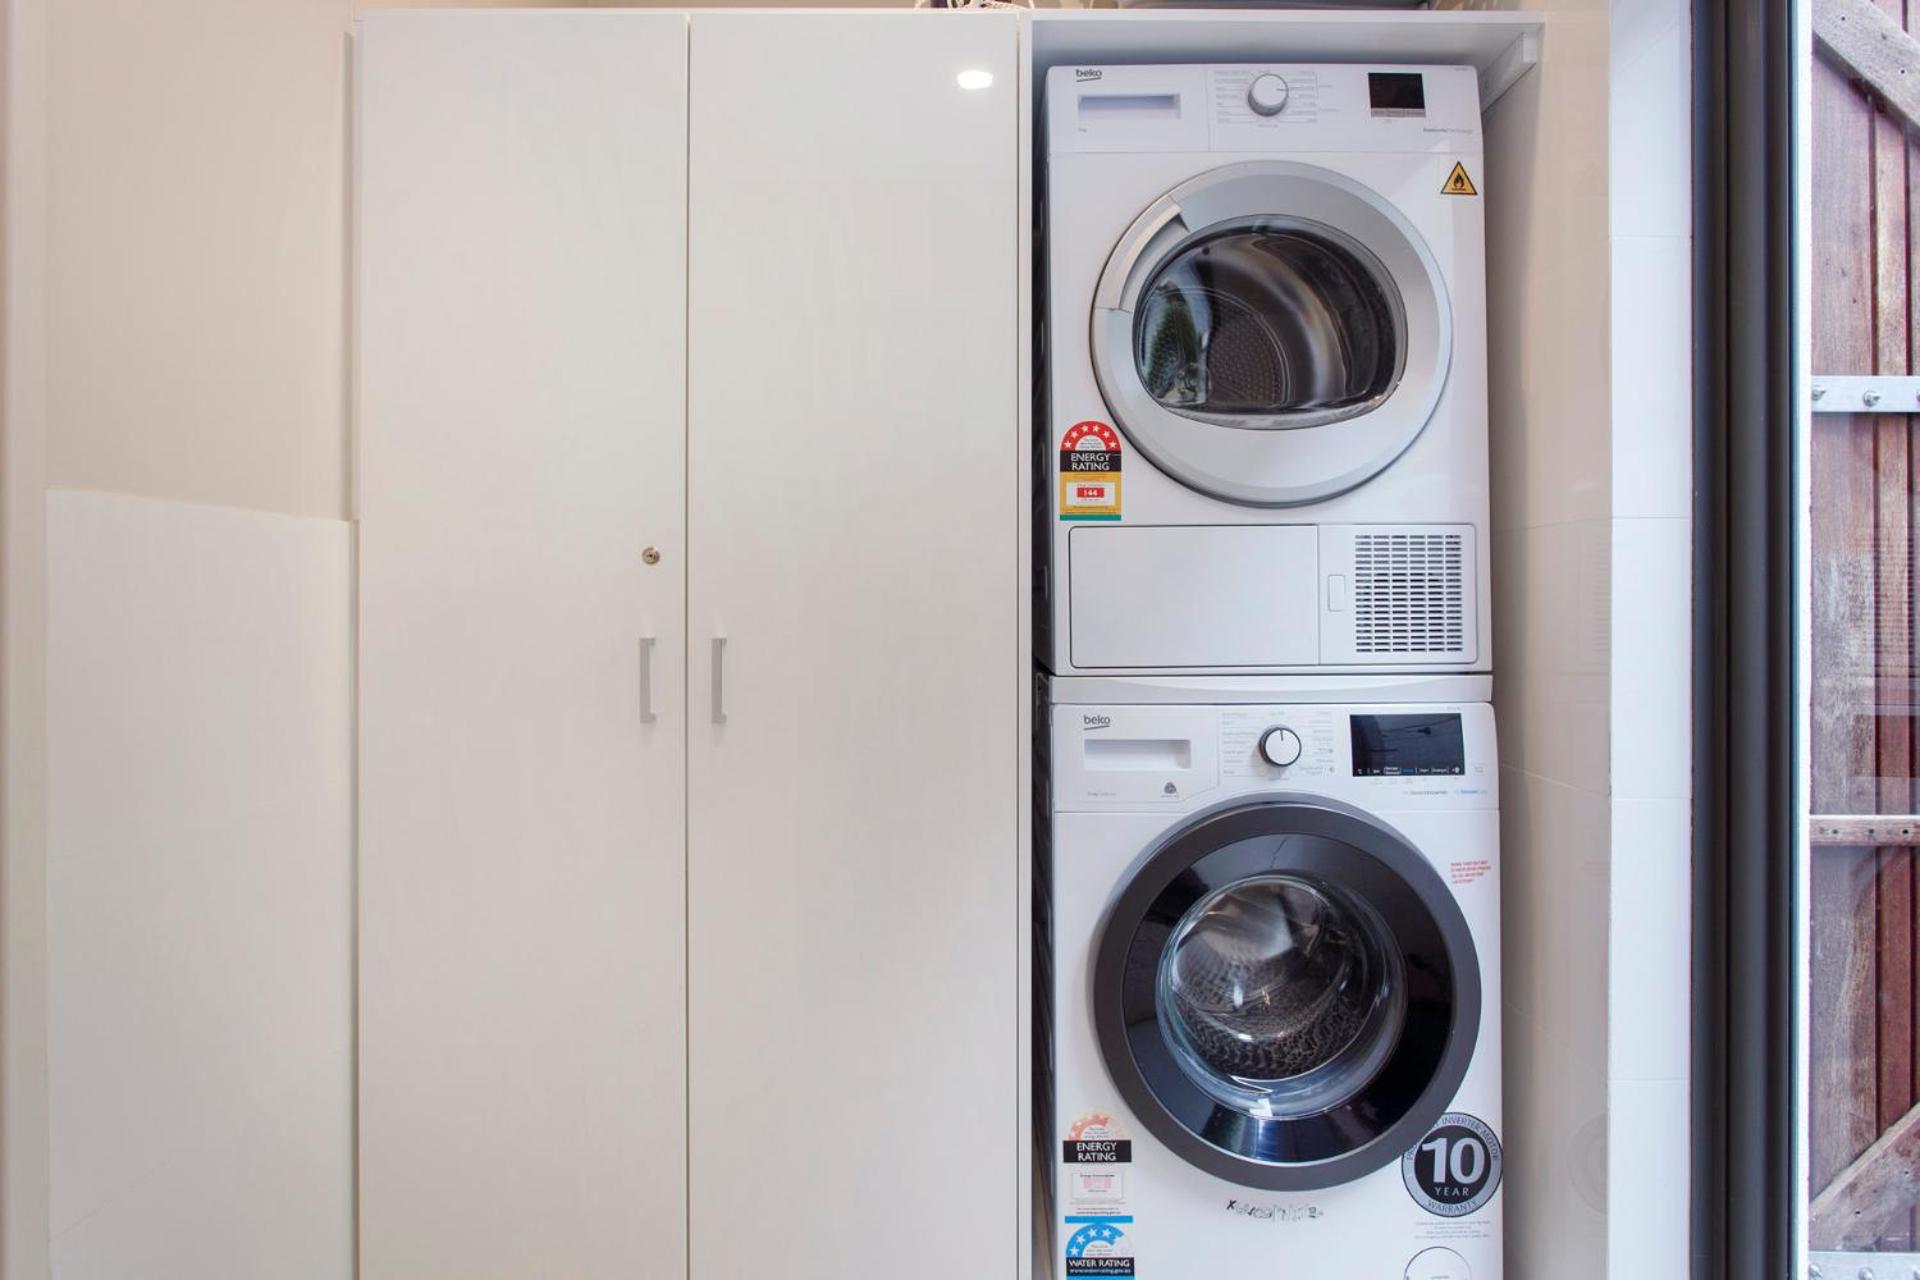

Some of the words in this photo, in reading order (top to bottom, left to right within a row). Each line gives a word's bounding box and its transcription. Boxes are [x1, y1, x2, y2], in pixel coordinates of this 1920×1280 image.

[1075, 68, 1103, 79] beko
[1071, 452, 1111, 462] ENERGY
[1071, 462, 1110, 471] RATING
[1083, 489, 1098, 497] 144
[1083, 714, 1111, 726] beko
[1441, 1115, 1482, 1134] INVERTER
[1479, 1128, 1500, 1160] MOTOR
[1076, 1142, 1117, 1151] ENERGY
[1077, 1152, 1117, 1161] RATING
[1422, 1137, 1485, 1184] 10
[1434, 1186, 1470, 1196] YEAR
[1428, 1199, 1479, 1214] WARRANTY
[1068, 1259, 1097, 1267] WATER
[1099, 1259, 1130, 1267] RATING
